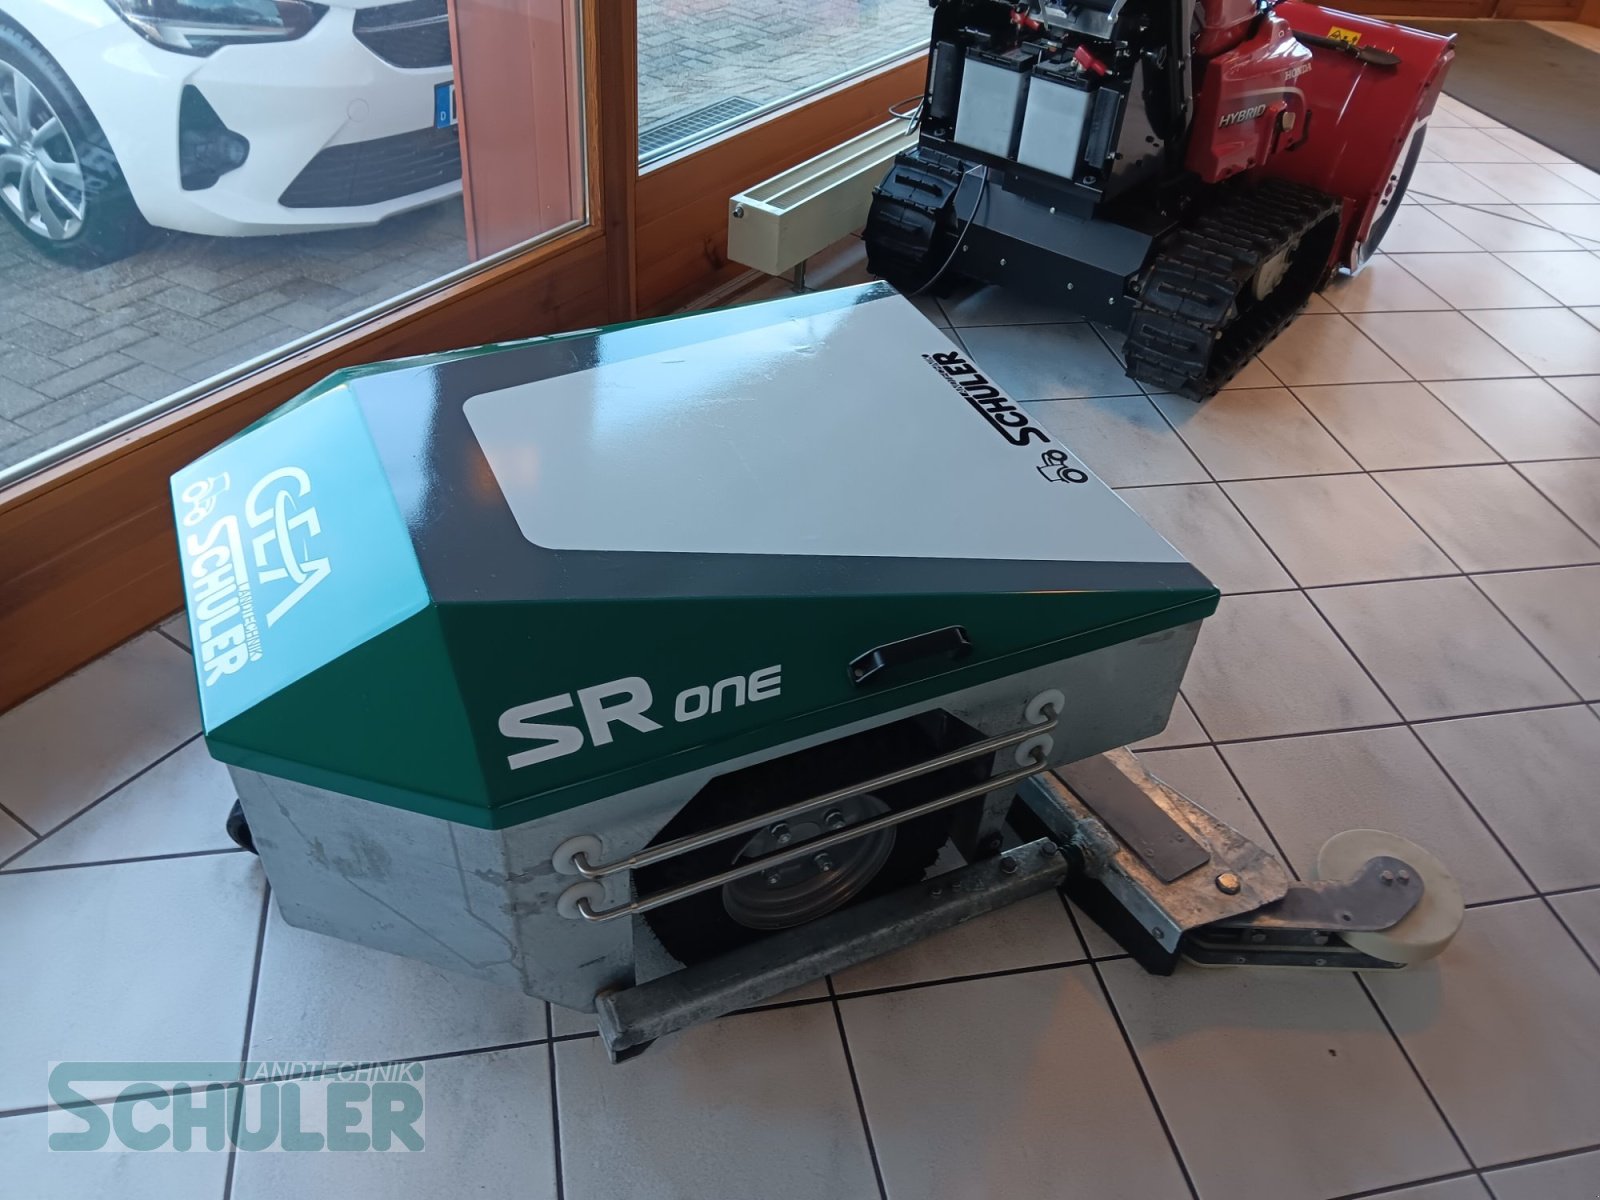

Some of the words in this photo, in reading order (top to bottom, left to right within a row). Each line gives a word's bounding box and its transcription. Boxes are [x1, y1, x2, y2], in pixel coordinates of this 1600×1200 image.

[1284, 62, 1312, 80] HONDA
[440, 111, 447, 121] D
[1218, 104, 1266, 128] HYBRID
[932, 351, 1051, 446] SCHULER
[186, 515, 250, 687] SCHULER
[498, 676, 664, 770] SR
